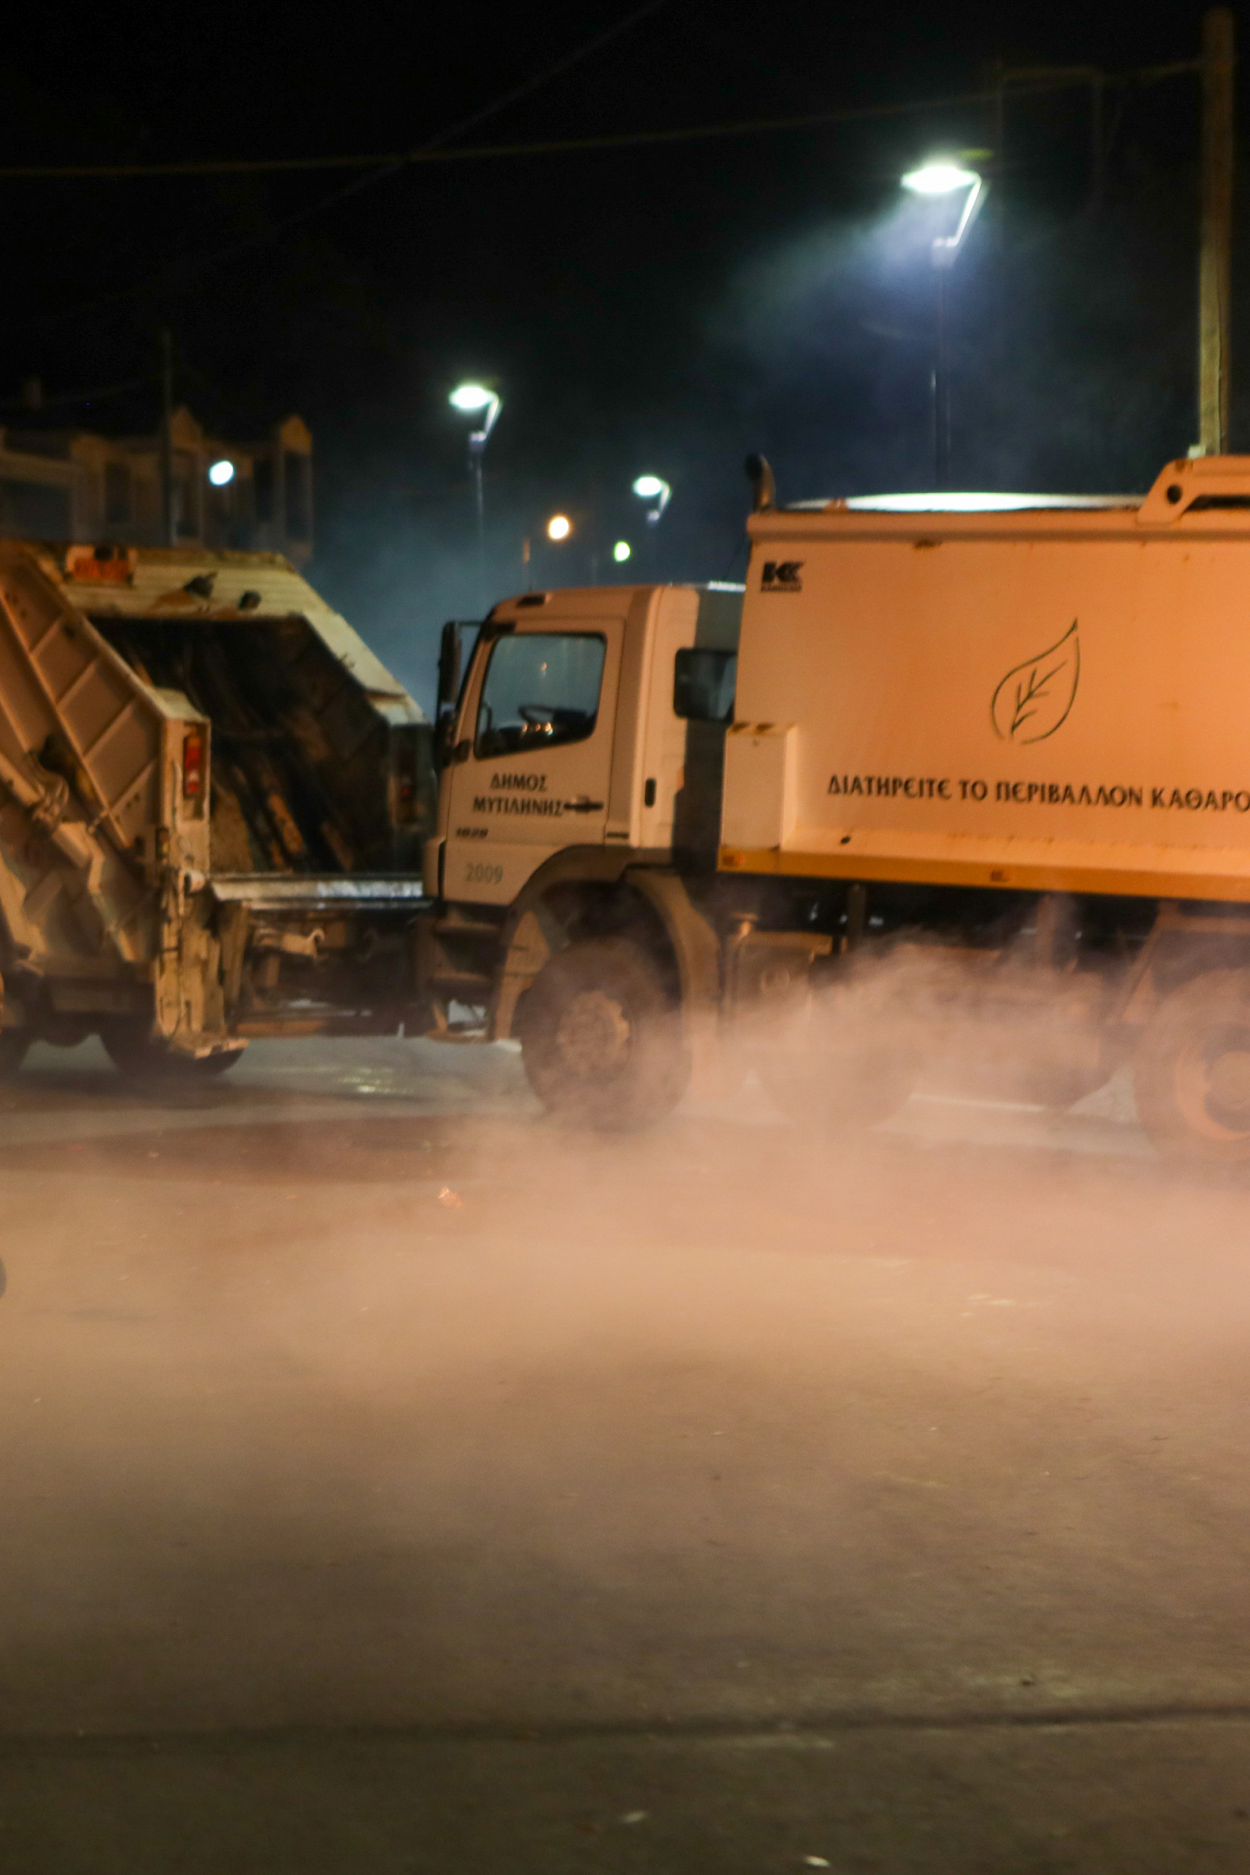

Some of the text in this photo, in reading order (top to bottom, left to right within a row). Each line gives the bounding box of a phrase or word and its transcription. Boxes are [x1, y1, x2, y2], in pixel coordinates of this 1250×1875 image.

[490, 772, 547, 792] ΔΗΜΟΣ
[827, 774, 1250, 813] ΔΙΑΤΗΡΕΙΤΕ ΤΟ ΠΕΡΙΒΑΛΛΟΝ ΚΑΘΑΡΟ
[473, 796, 564, 817] ΜΥΤΙΛΗΝΗΣ
[464, 861, 503, 884] 2009
